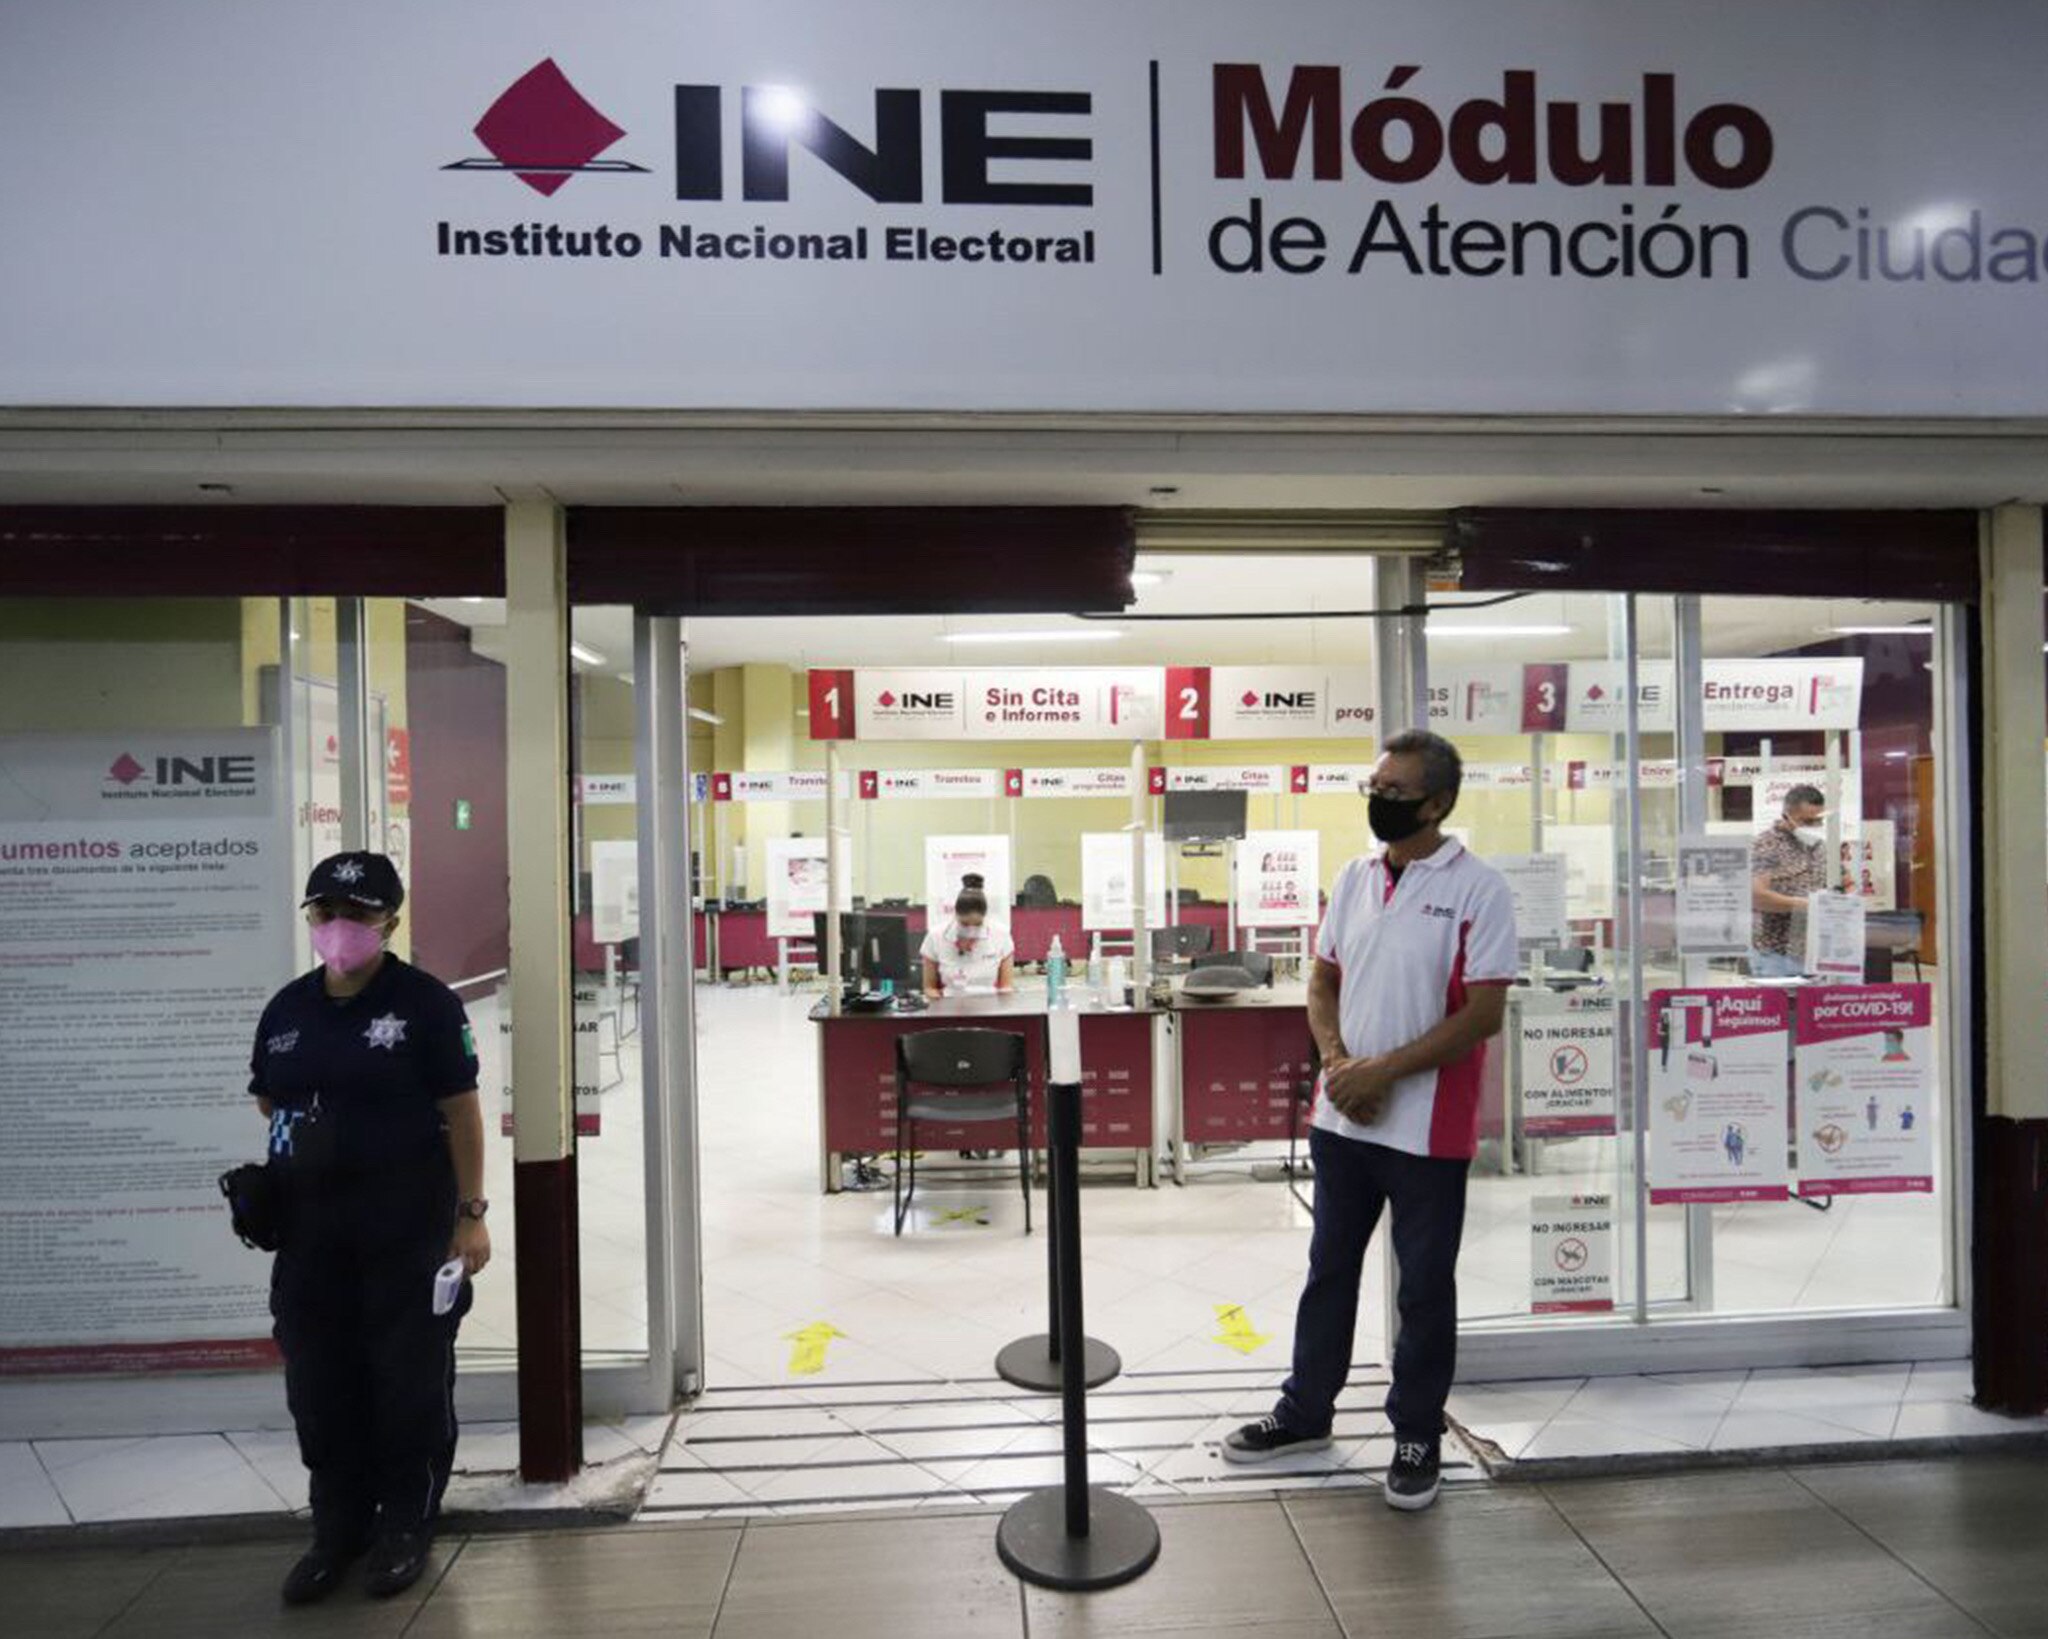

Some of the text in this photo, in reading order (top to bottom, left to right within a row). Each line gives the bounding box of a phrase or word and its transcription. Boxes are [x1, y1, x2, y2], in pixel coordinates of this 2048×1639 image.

[1213, 63, 1774, 190] Módulo
[675, 83, 1094, 206] INE
[437, 221, 1095, 264] Instituto Nacional Electoral
[1207, 197, 2048, 284] de Atención Ciuda
[985, 688, 1080, 707] Sin Cita
[1536, 681, 1556, 713] 3
[1616, 685, 1661, 701] IE
[1704, 682, 1794, 702] Entrega
[824, 687, 954, 720] 1 INE
[1178, 687, 1316, 719] 2 INE
[985, 708, 1081, 722] e Informes
[156, 756, 255, 785] INE
[1096, 771, 1126, 782] Citas
[1240, 769, 1270, 780] Citas
[101, 787, 256, 799] Instituto Nacional Electoral
[864, 778, 875, 791] 7
[129, 837, 259, 860] aceptados
[1582, 997, 1613, 1008] INE
[1716, 995, 1762, 1016] ¡Aquí
[1813, 1000, 1914, 1021] por COVID-19!
[1718, 1013, 1781, 1029] seguimos!
[1524, 1027, 1613, 1040] NO INGRESAR
[1524, 1089, 1548, 1100] CON
[1532, 1220, 1611, 1234] NO INGRESAR
[1533, 1276, 1556, 1287] CON
